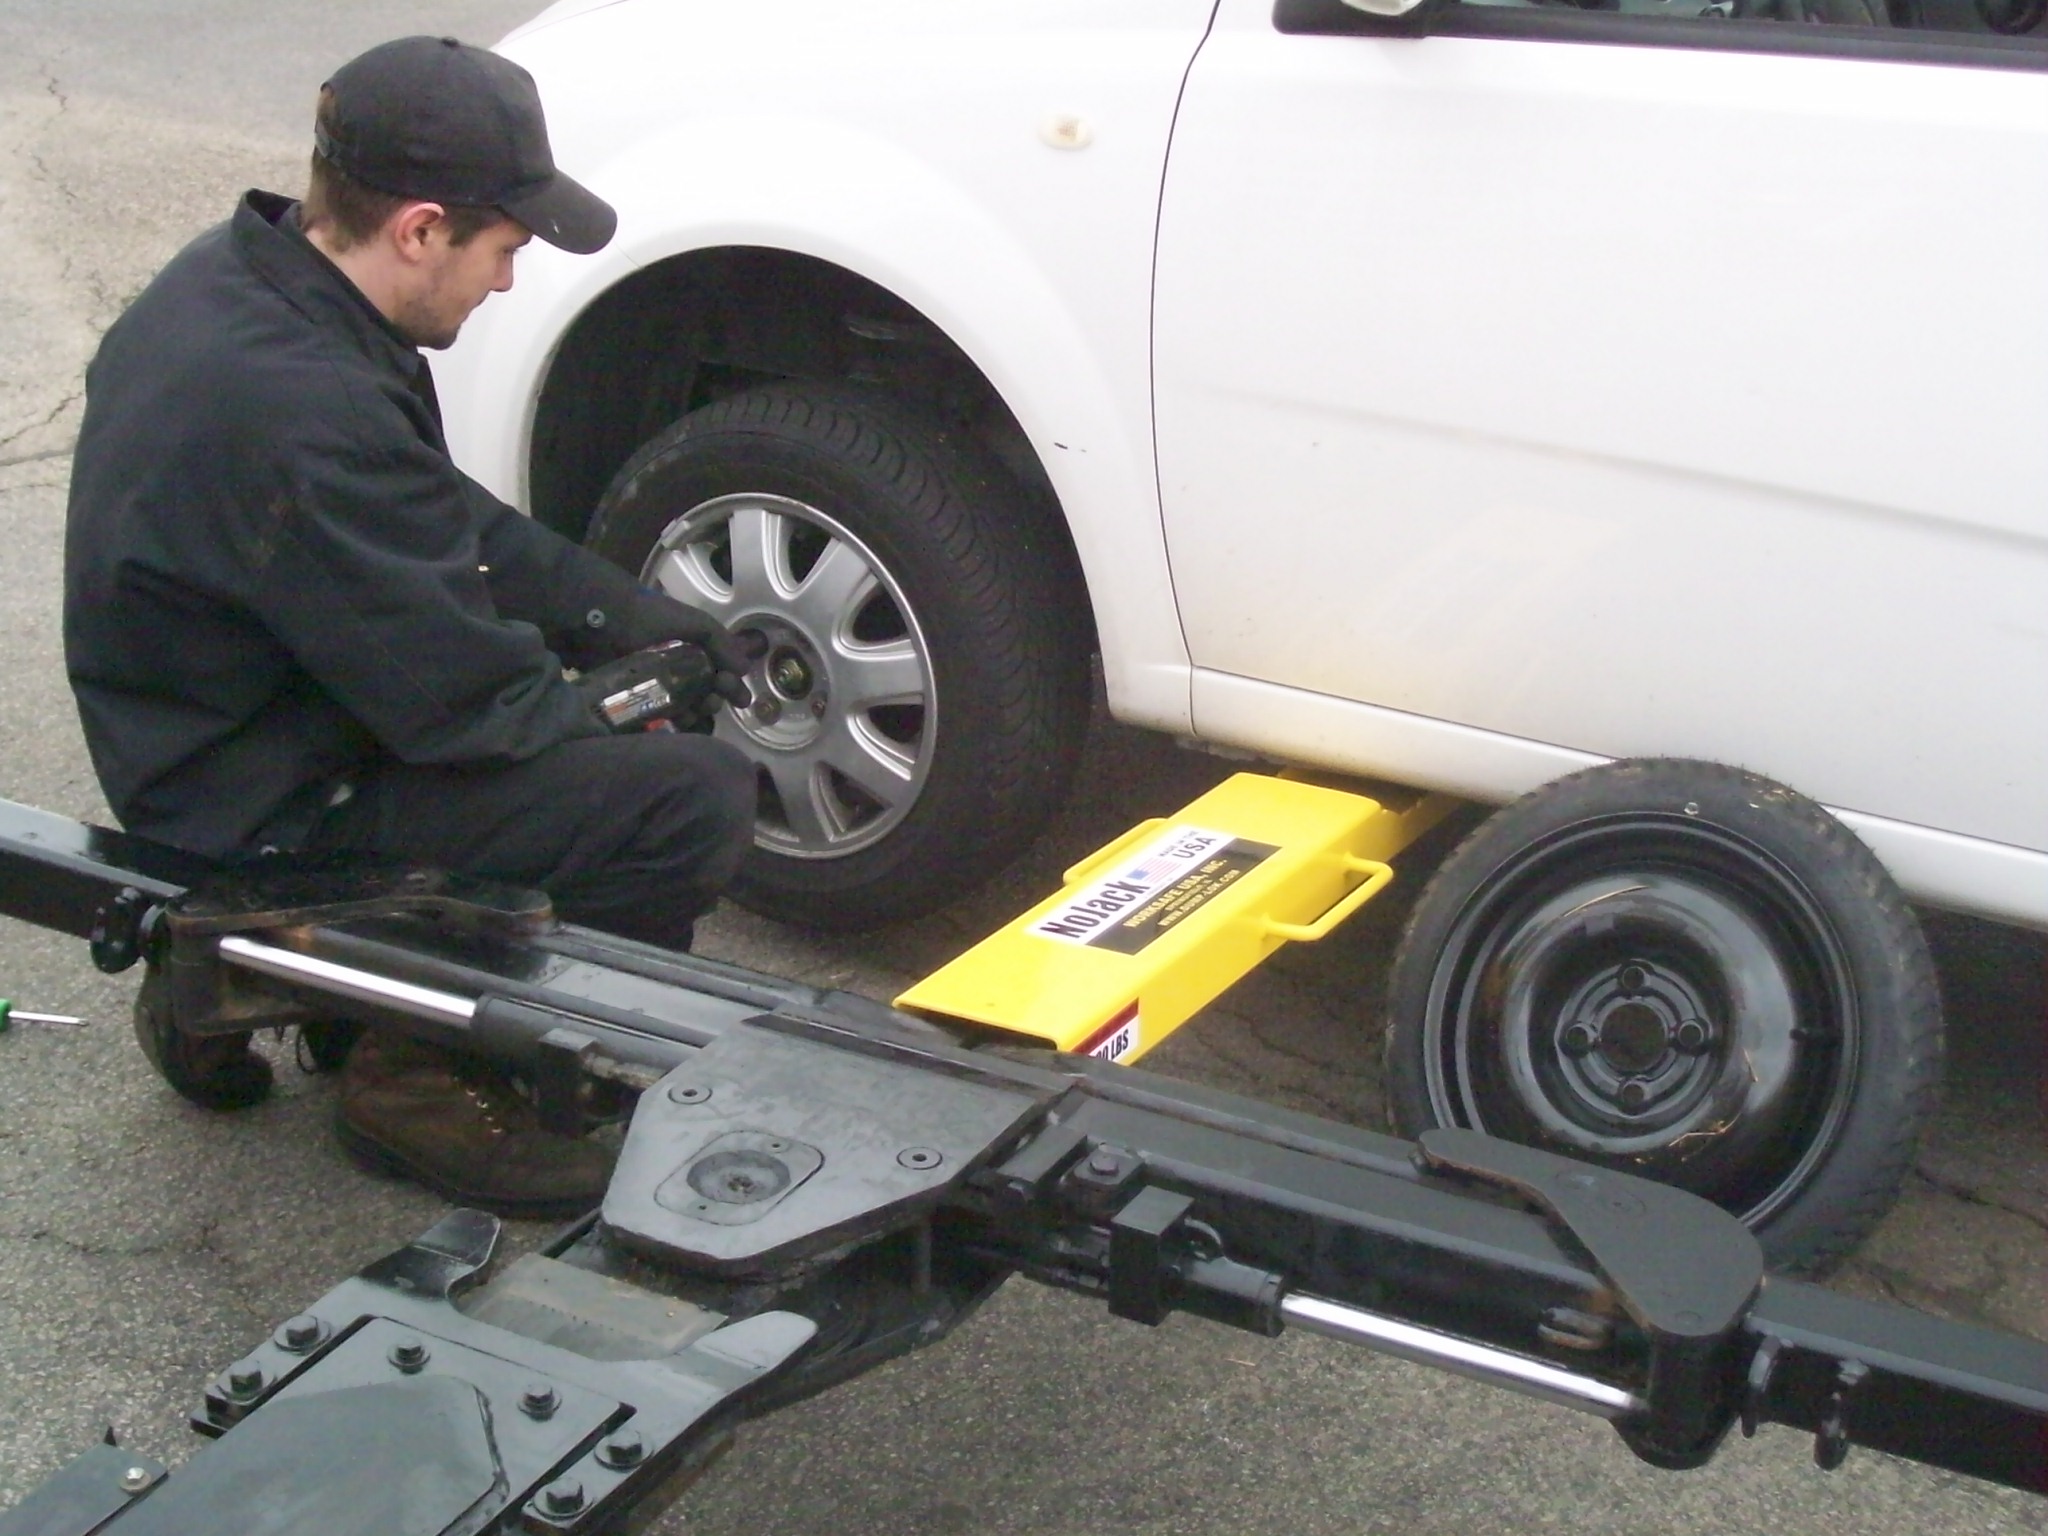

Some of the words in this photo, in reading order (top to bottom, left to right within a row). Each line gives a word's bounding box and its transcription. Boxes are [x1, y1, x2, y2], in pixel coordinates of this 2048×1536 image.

[1172, 837, 1217, 859] USA
[1039, 880, 1151, 939] NoJack
[1122, 889, 1184, 928] WORKSAFE
[1176, 874, 1209, 890] USA,
[1200, 859, 1228, 874] INC.
[1111, 1028, 1129, 1060] LBS
